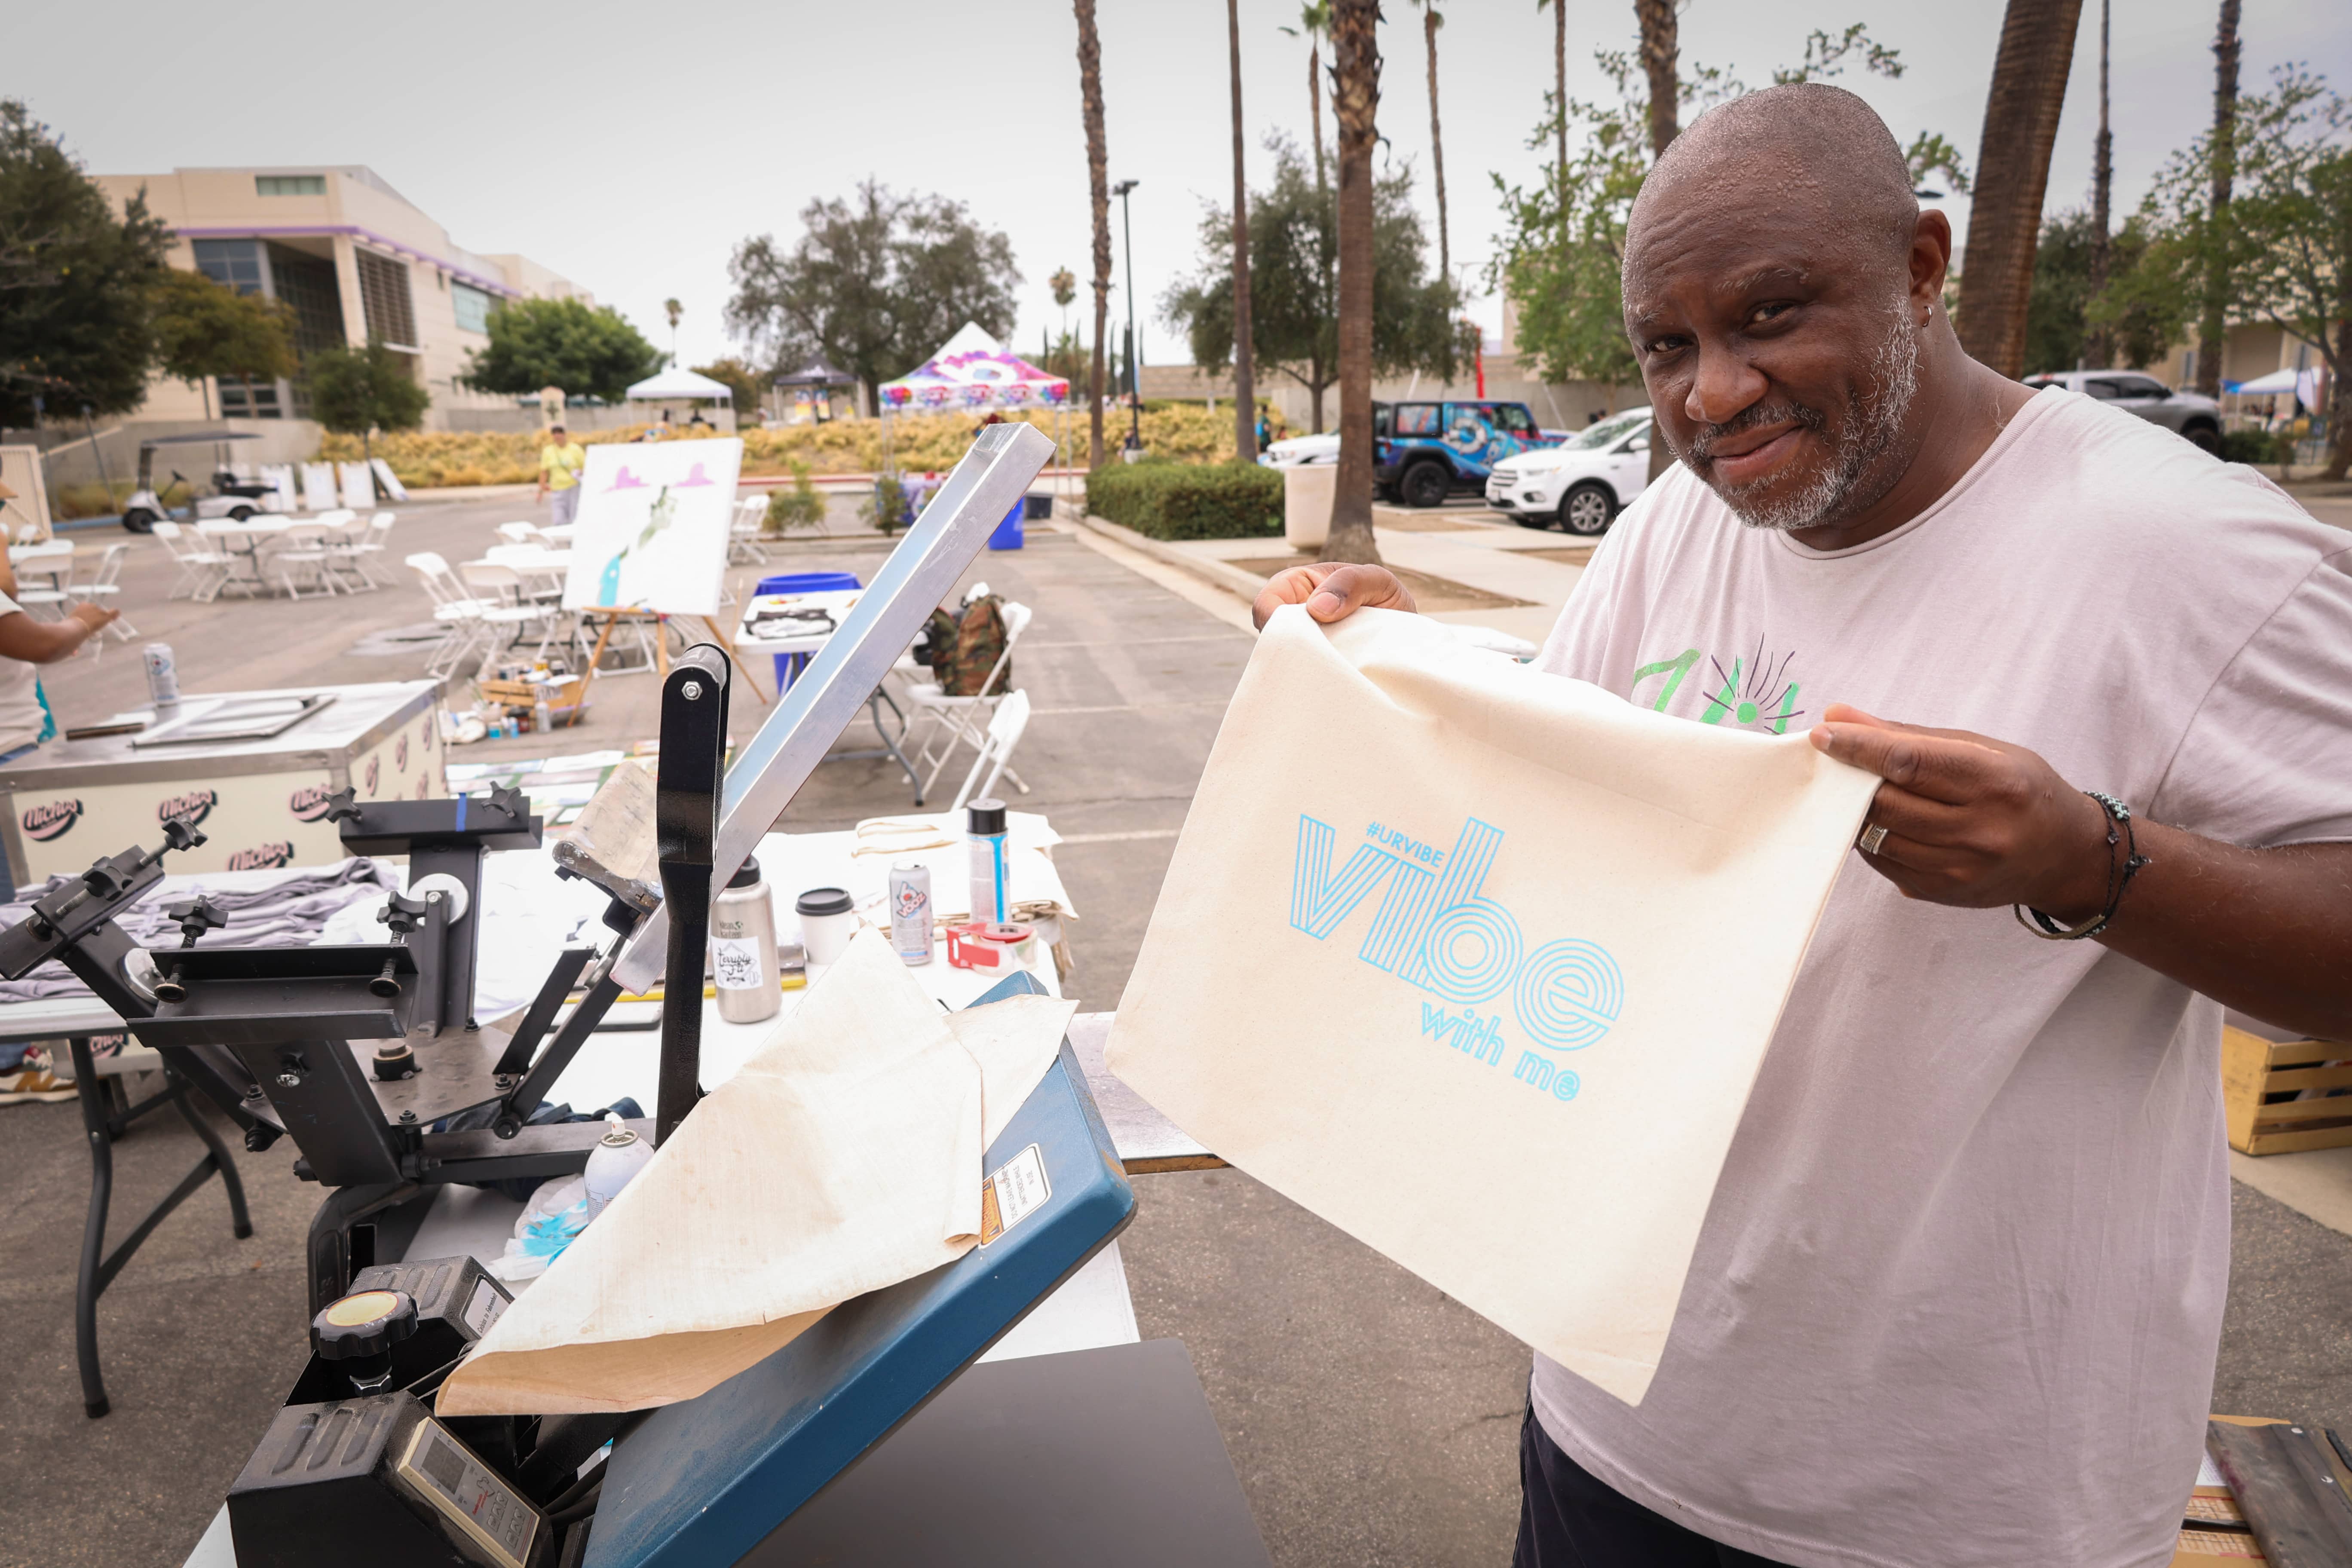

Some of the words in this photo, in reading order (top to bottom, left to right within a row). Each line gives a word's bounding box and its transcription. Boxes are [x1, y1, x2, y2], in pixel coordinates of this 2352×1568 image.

[1366, 821, 1446, 868] #URVIBE
[897, 891, 927, 918] VOOZ
[1421, 1001, 1505, 1067] with
[1513, 1050, 1580, 1102] me
[477, 1318, 487, 1333] Celsius
[485, 1292, 498, 1314] Fahrenheit
